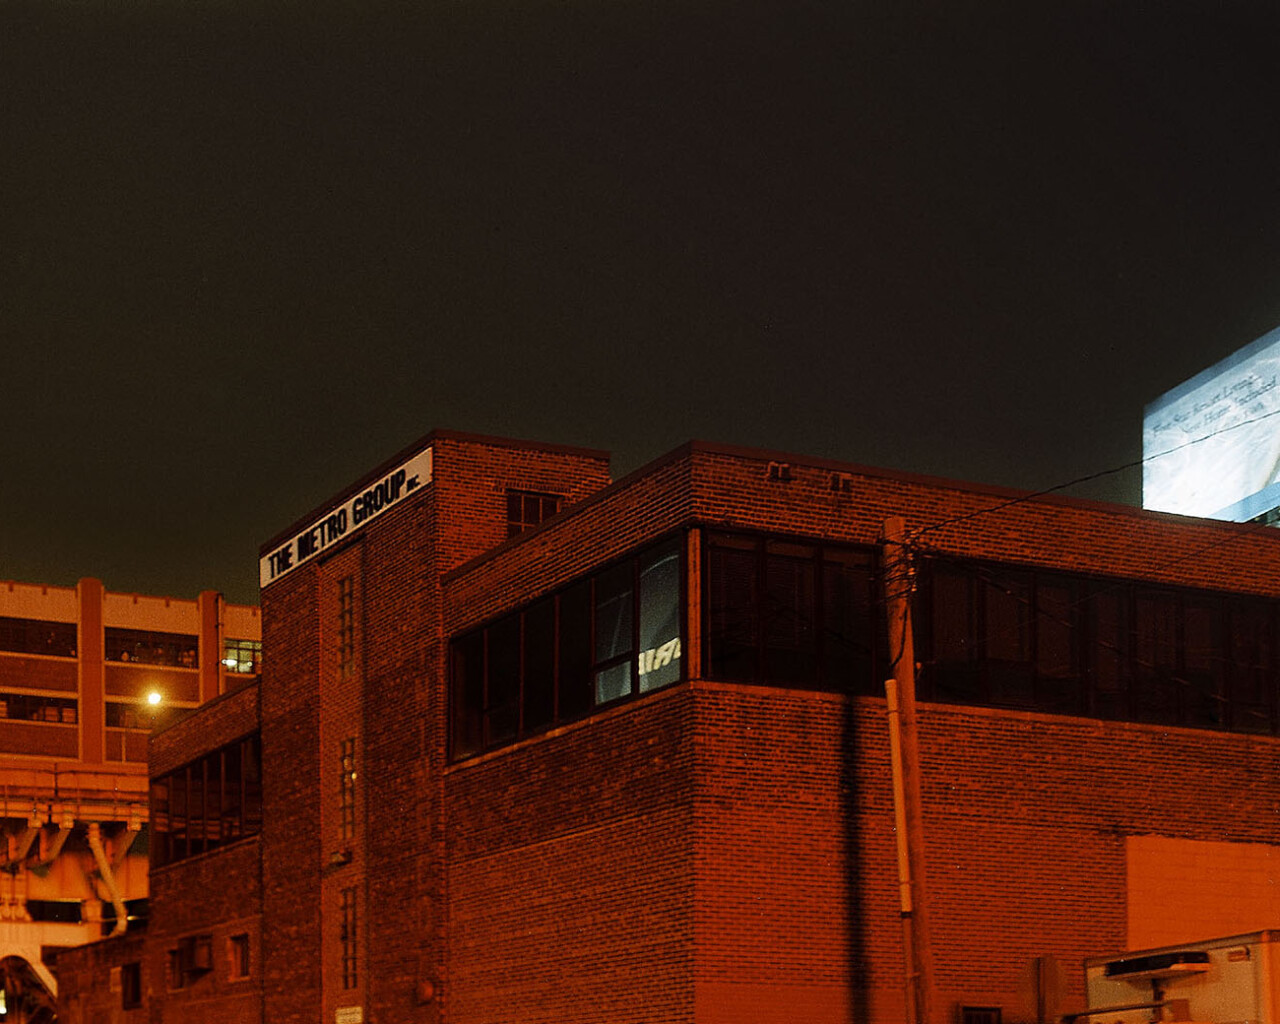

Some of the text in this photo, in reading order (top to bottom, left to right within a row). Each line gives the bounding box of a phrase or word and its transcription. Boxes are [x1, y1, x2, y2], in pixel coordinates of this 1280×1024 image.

[268, 543, 293, 579] THE
[298, 509, 347, 562] METRO
[353, 468, 406, 526] GROUP
